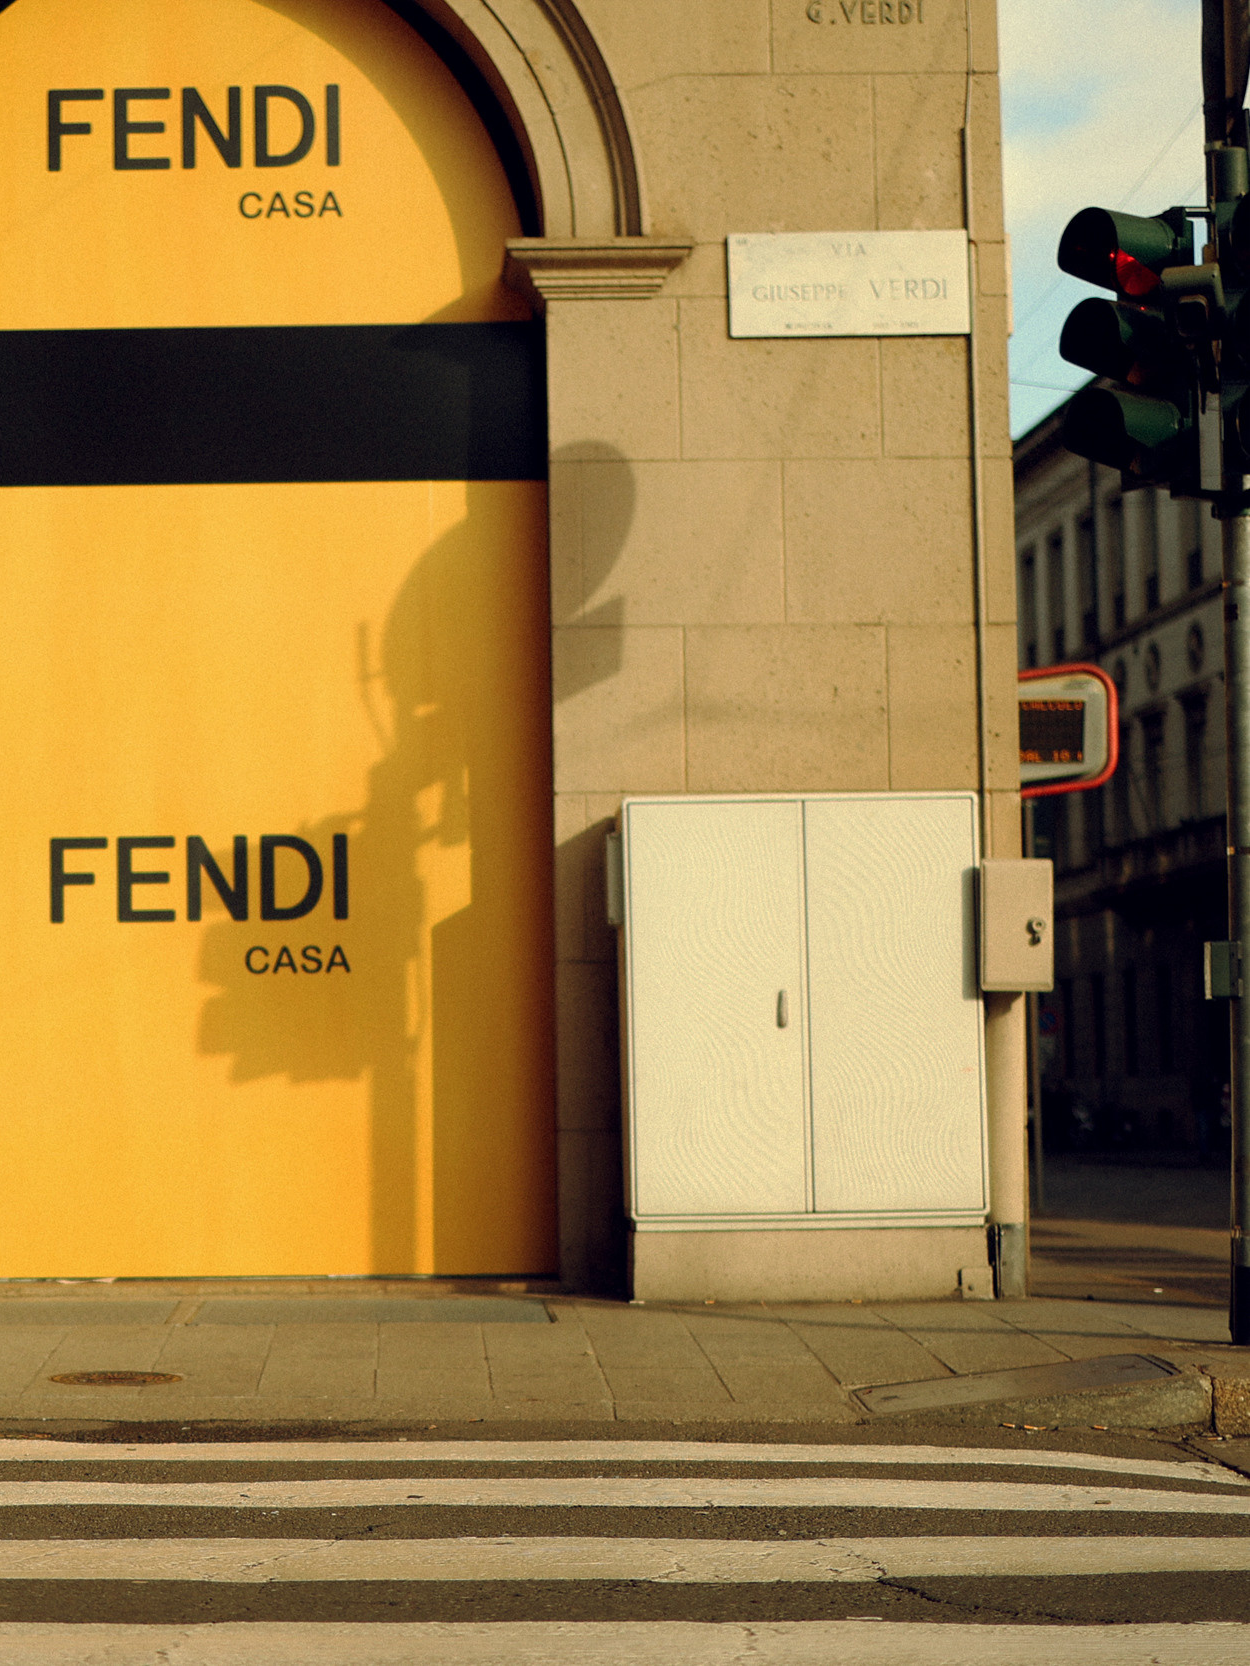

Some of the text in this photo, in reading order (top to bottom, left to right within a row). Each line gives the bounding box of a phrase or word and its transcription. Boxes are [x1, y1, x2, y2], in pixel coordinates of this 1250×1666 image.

[48, 84, 340, 172] FENDI
[239, 191, 343, 219] CASA
[831, 242, 867, 256] VIA
[751, 277, 948, 302] GIUSEPPE VERDI
[50, 833, 349, 923] FENDI
[245, 945, 351, 974] CASA
